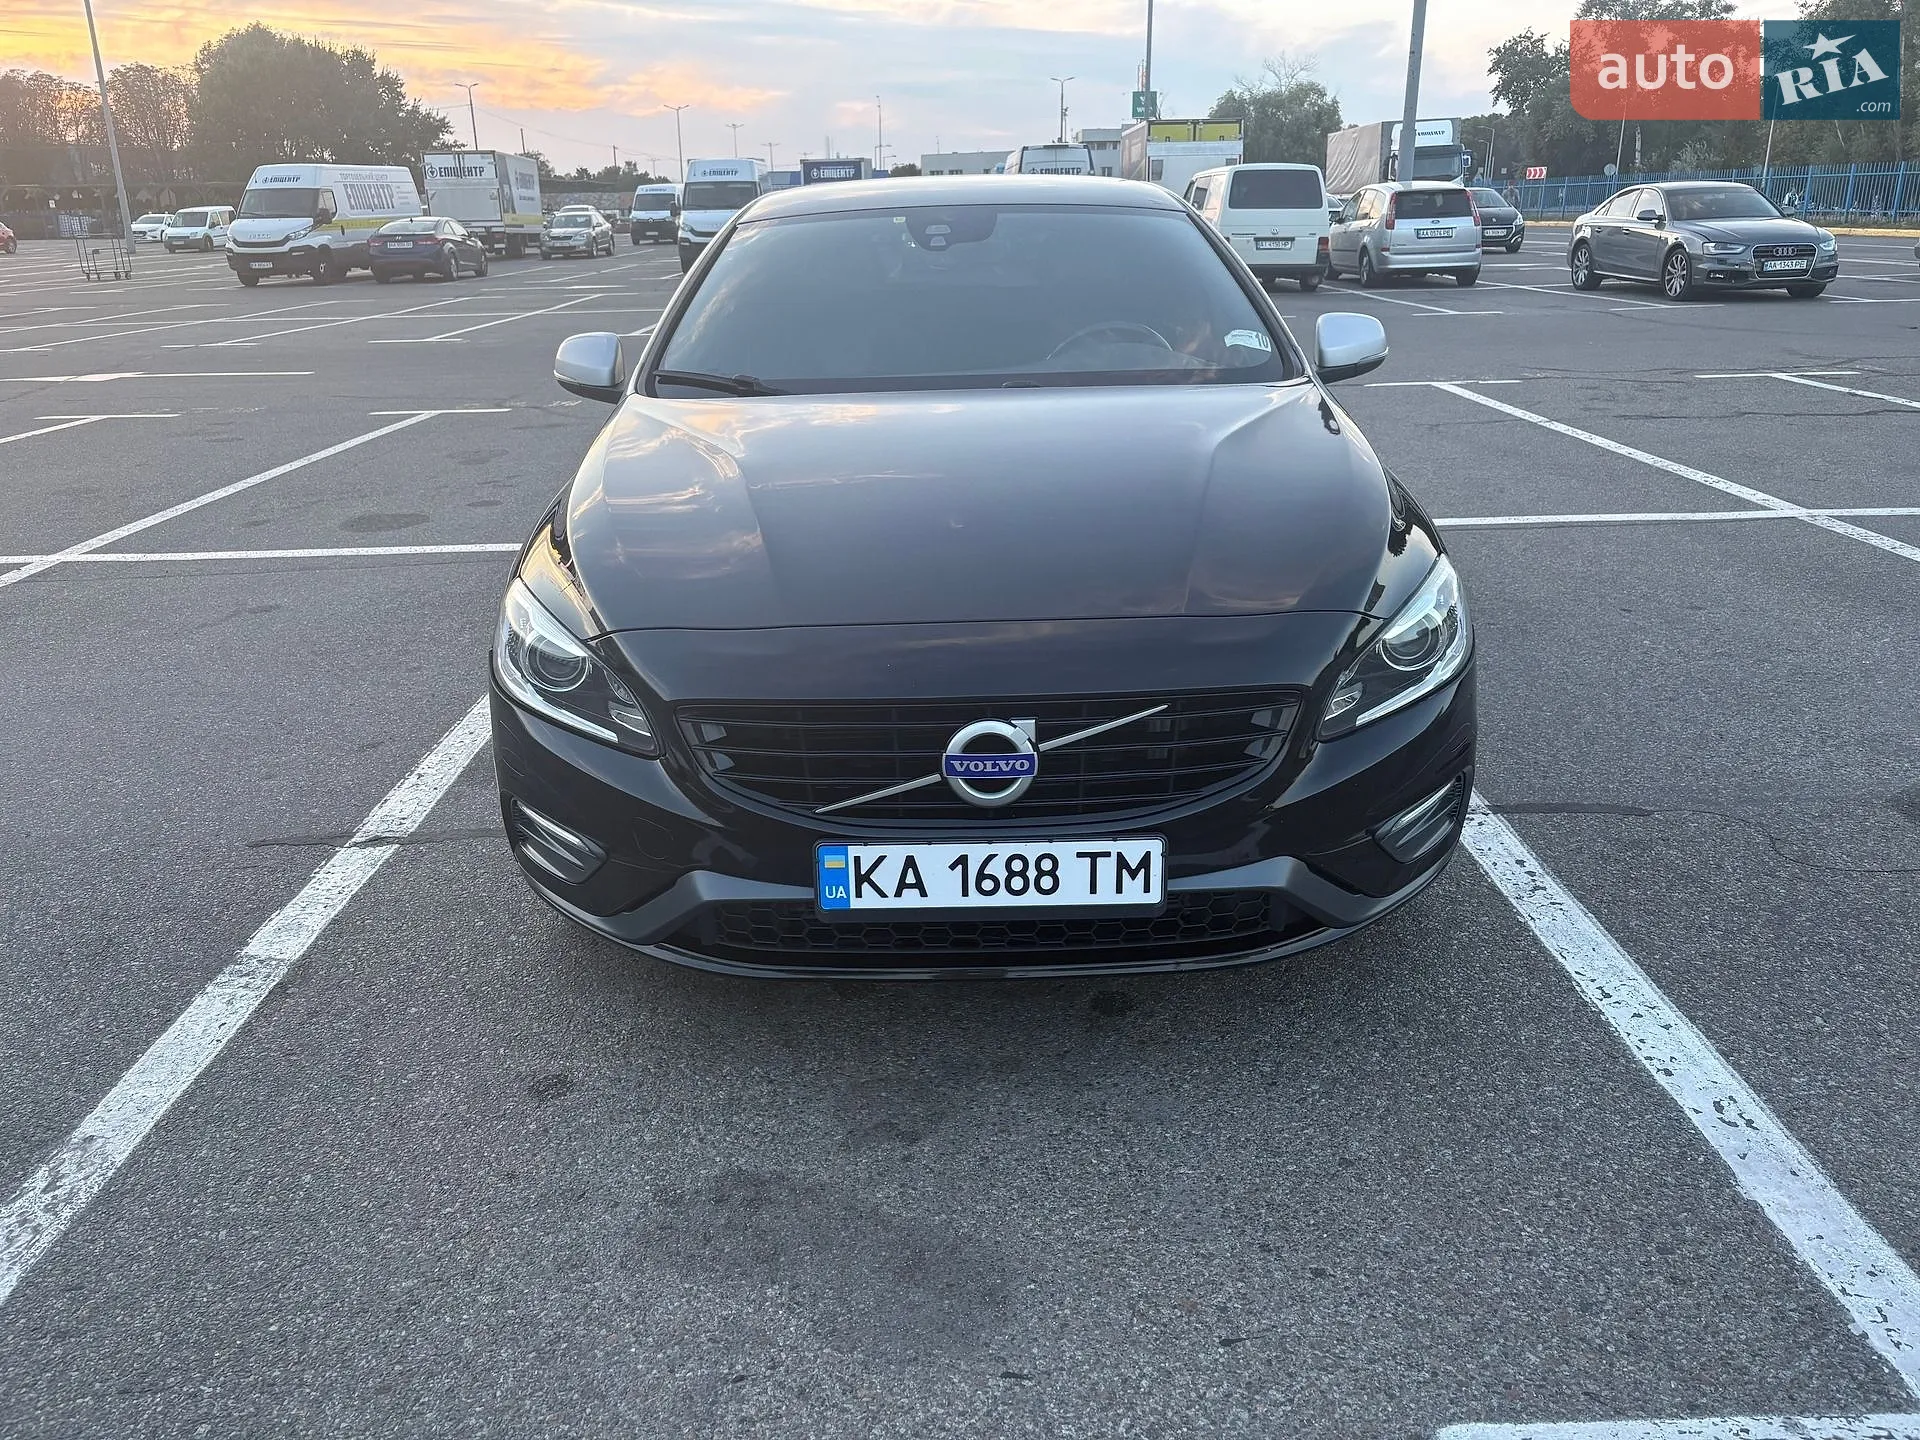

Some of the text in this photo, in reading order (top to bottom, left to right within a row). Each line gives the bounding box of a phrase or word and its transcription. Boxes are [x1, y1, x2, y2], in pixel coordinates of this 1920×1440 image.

[438, 166, 485, 178] ЕПІЦЕНТР
[820, 168, 855, 178] ЕПІЦЕНТР
[342, 183, 395, 212] ЕПІЦЕНТР
[949, 758, 1031, 773] VOLVO
[853, 850, 1152, 899] KA 1688 TM
[825, 885, 847, 900] UA
